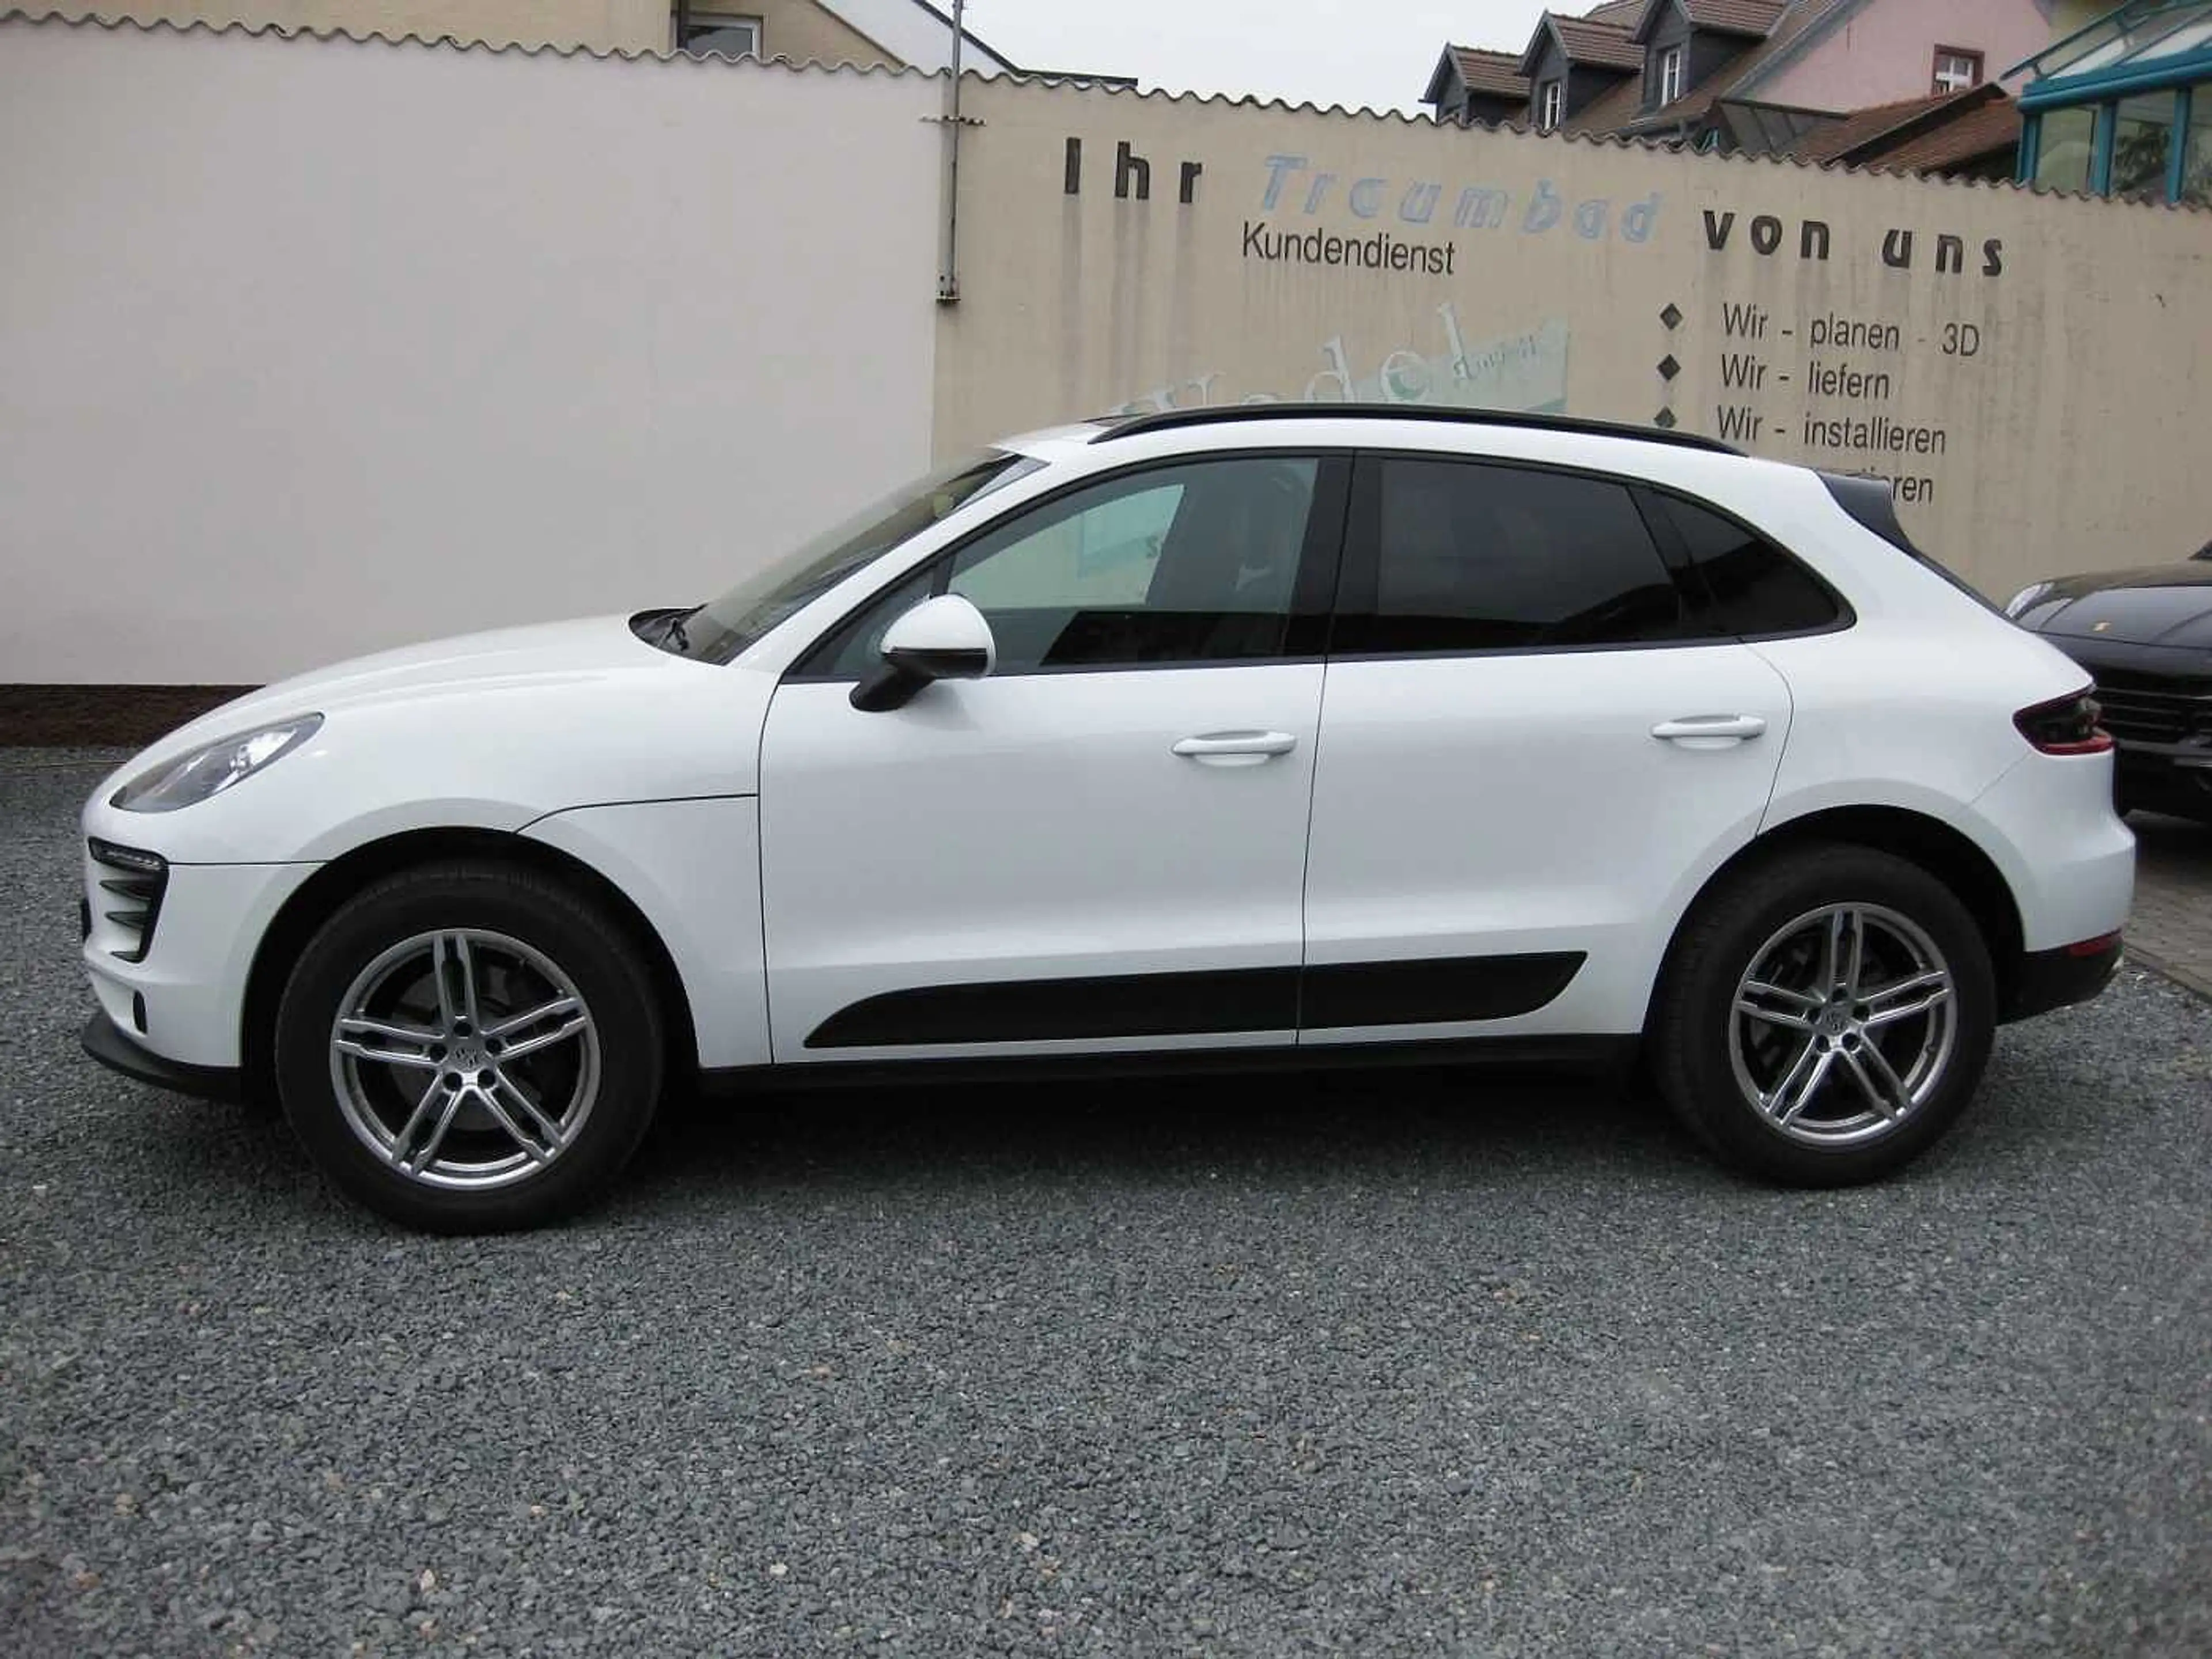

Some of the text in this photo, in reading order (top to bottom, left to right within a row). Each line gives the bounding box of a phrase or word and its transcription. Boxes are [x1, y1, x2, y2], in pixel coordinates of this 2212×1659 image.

[1064, 137, 1203, 204] Ihr
[1703, 210, 1830, 260] von
[1881, 229, 2003, 277] uns
[1242, 221, 1455, 275] Kundendienst
[1723, 302, 1769, 341] Wir
[1809, 311, 1900, 351] planen
[1942, 322, 1980, 357] 3D
[1721, 353, 1767, 390] Wir
[1808, 361, 1889, 399] liefern
[1717, 404, 1764, 444] Wir
[1803, 411, 1946, 455] installieren
